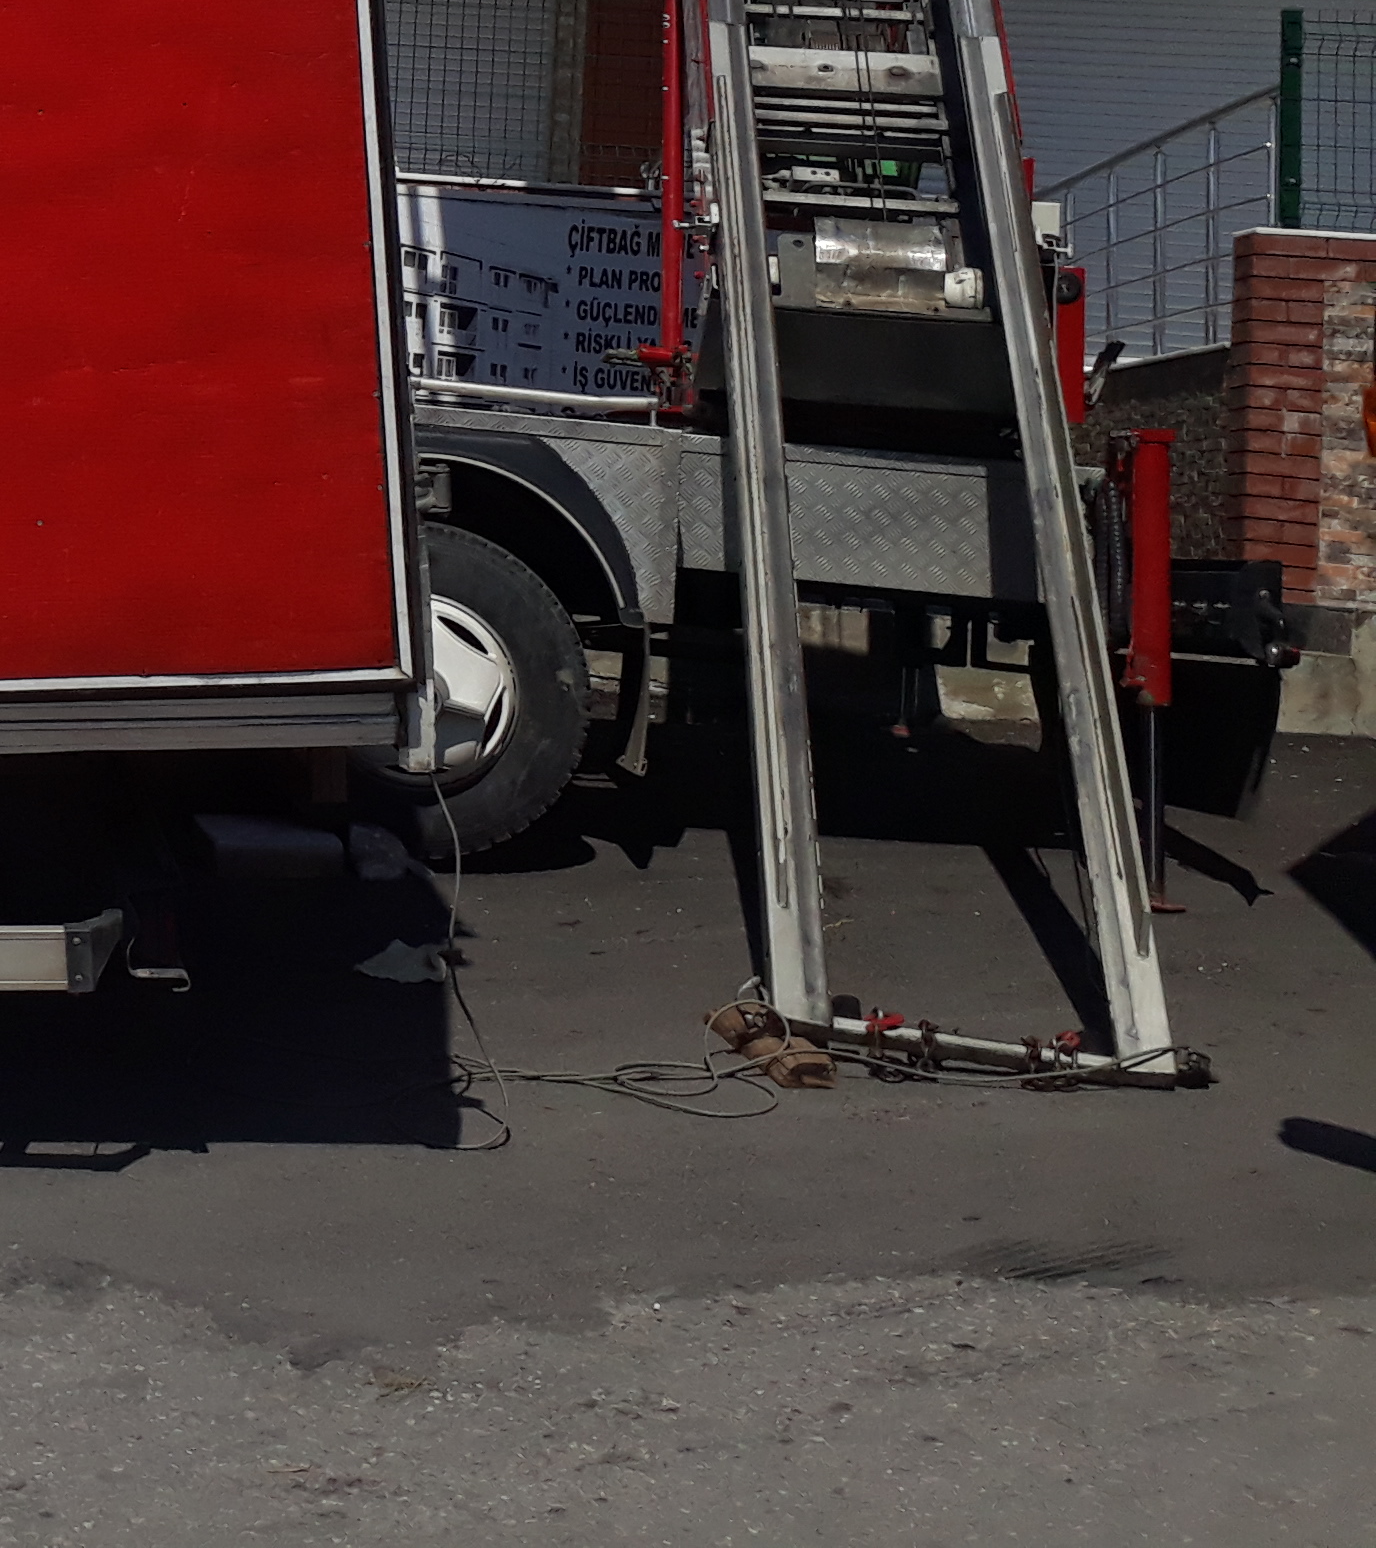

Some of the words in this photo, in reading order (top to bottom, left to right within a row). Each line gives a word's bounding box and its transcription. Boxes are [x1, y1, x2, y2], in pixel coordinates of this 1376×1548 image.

[568, 218, 642, 258] ÇİFTBAĞ
[578, 266, 622, 290] PLAN
[628, 270, 661, 293] PRO
[573, 360, 589, 393] İŞ
